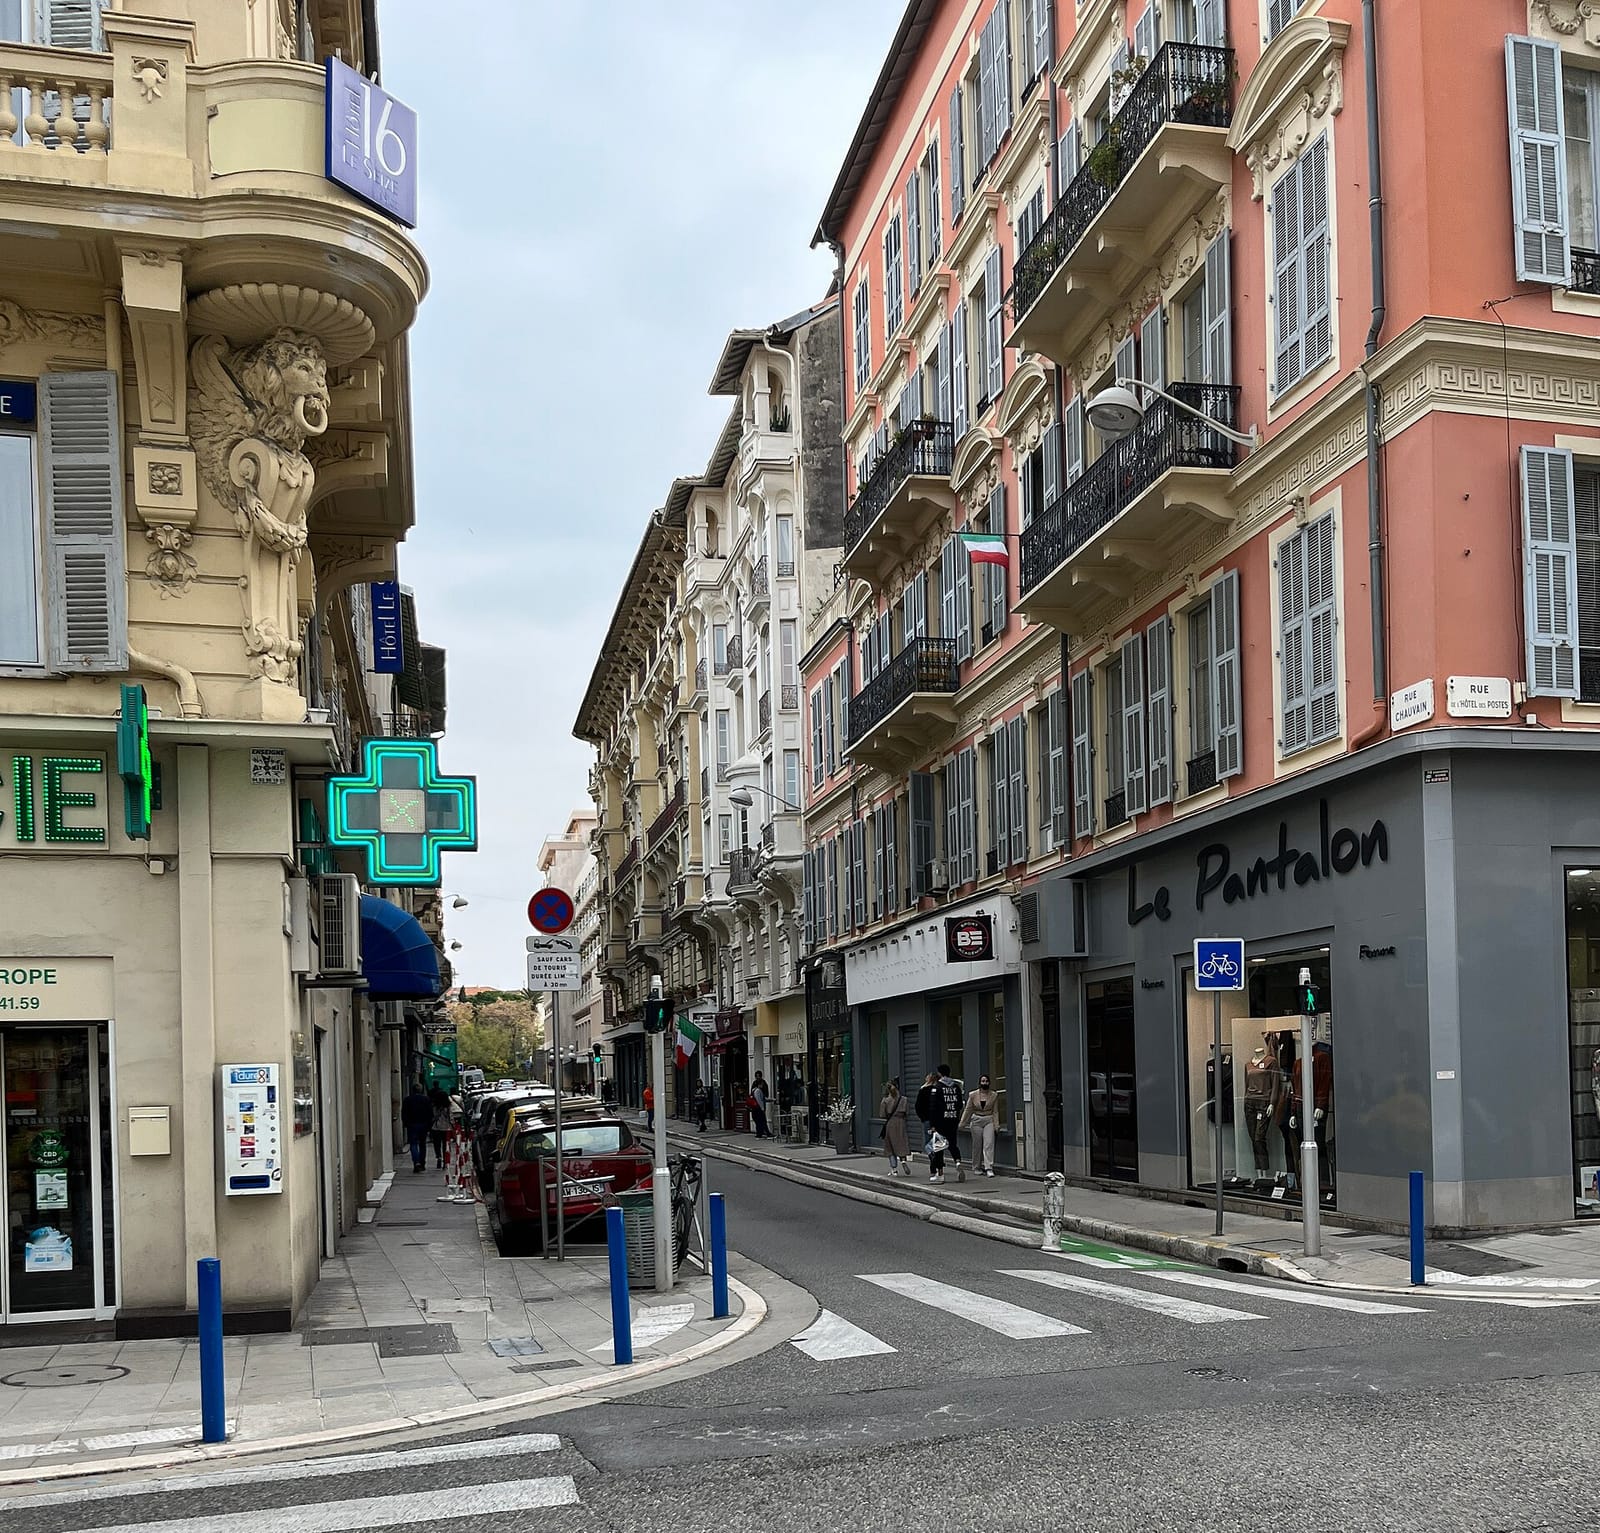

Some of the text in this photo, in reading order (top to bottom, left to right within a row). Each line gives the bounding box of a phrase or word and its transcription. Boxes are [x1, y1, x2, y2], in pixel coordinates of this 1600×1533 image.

[360, 82, 406, 176] 16
[0, 395, 13, 415] E
[377, 592, 395, 609] LE
[378, 616, 397, 660] HÔTEL
[1404, 690, 1417, 703] RUE
[1470, 684, 1489, 694] RUE
[1395, 701, 1427, 722] CHAUVAIN
[1487, 700, 1509, 709] POSTES
[0, 755, 105, 841] IE
[1128, 798, 1389, 926] Le Pantalon
[957, 930, 983, 946] BE
[1359, 944, 1396, 960] Femme
[0, 968, 57, 985] ROPE
[0, 997, 40, 1010] 41.59
